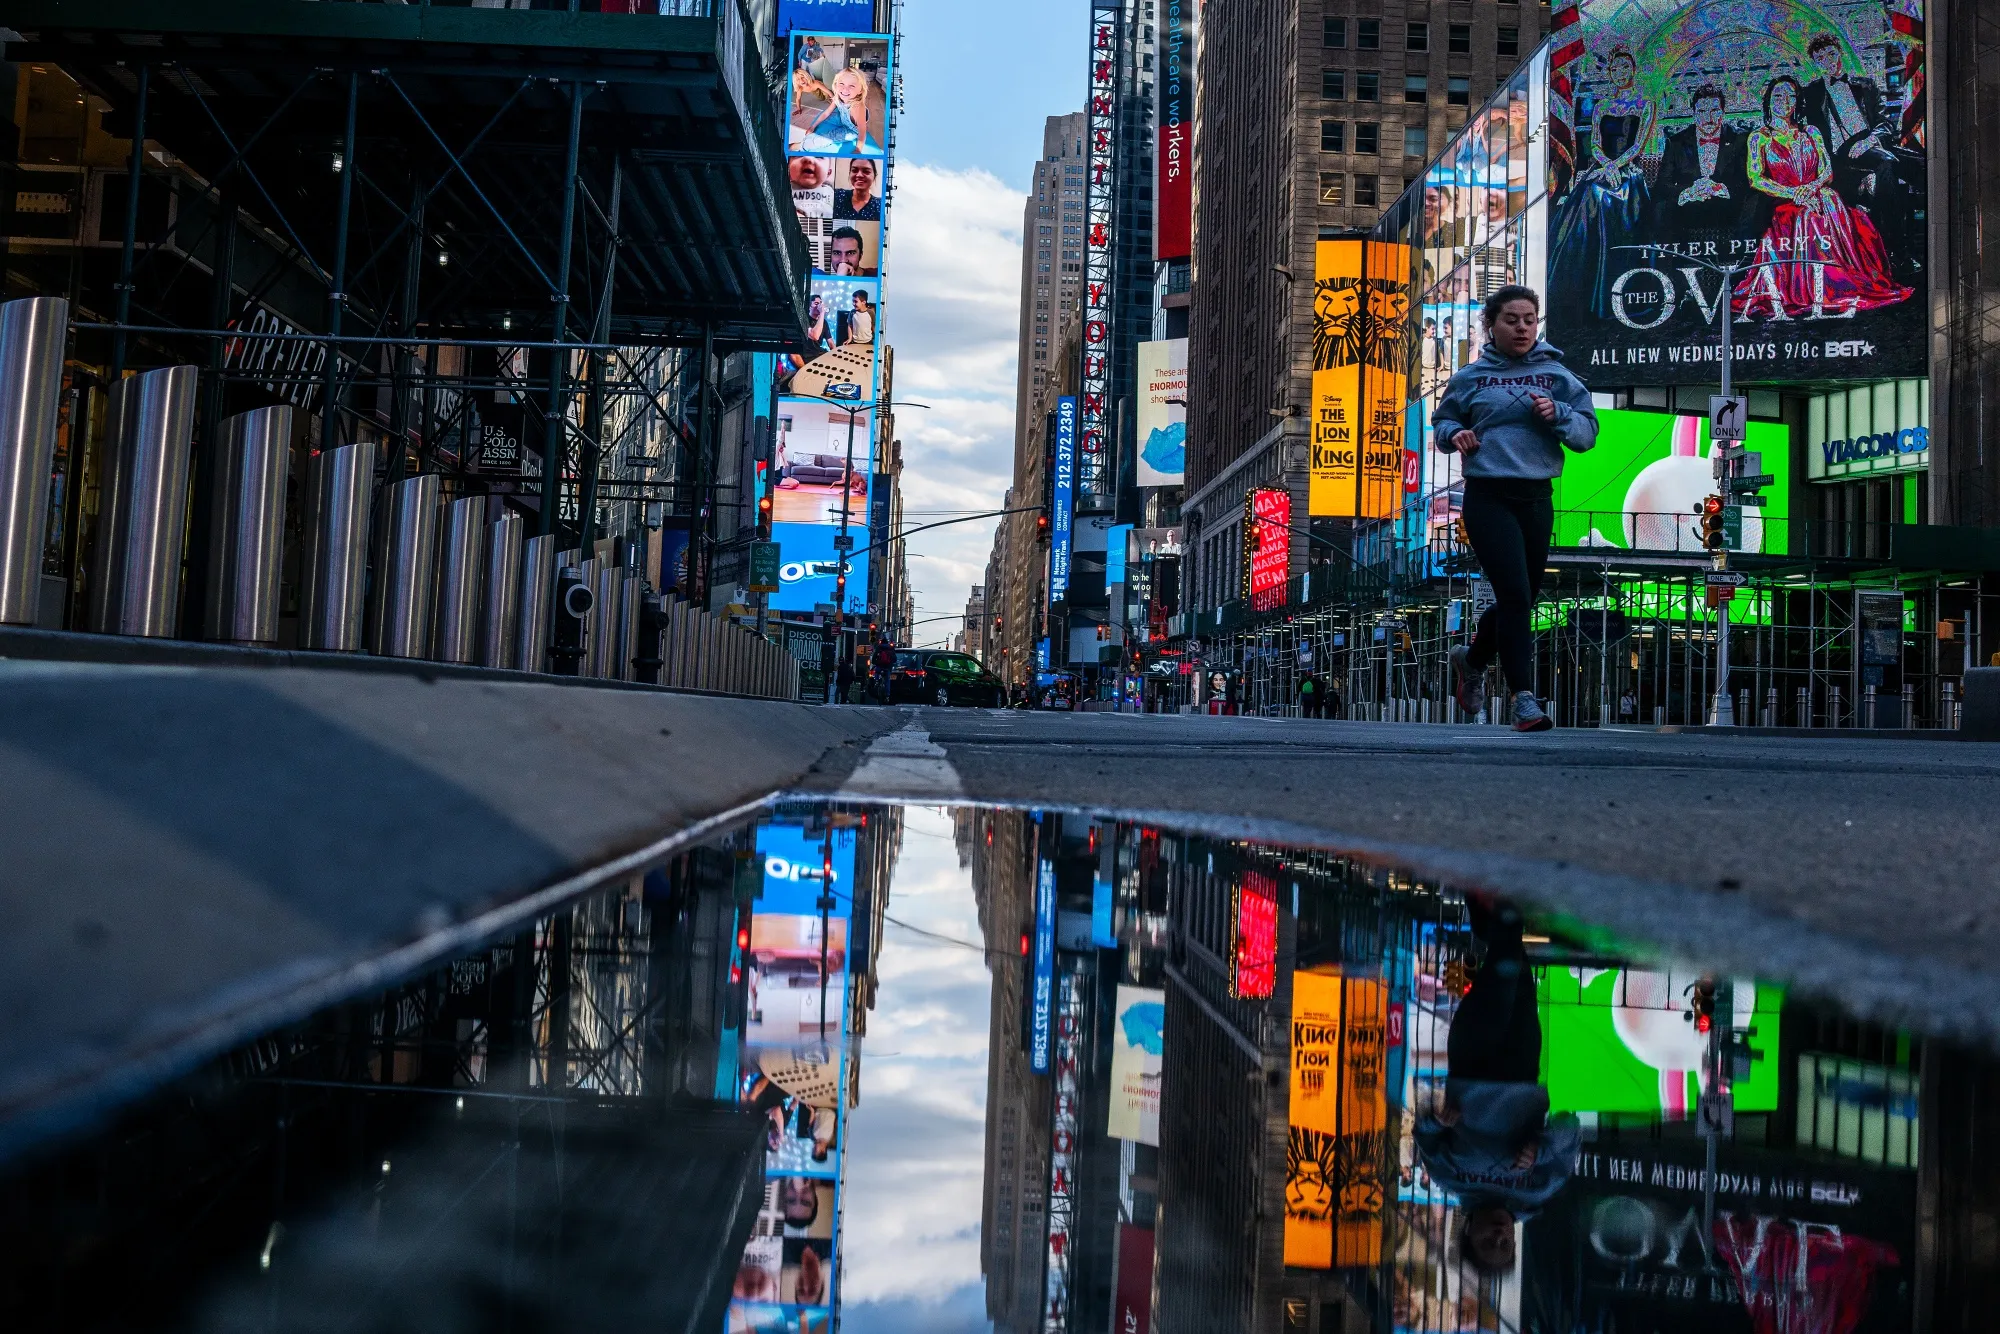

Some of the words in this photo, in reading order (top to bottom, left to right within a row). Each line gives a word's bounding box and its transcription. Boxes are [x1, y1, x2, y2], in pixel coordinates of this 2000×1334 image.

[1093, 26, 1111, 186] ERNST
[1168, 100, 1184, 183] workers.
[1639, 240, 1719, 259] TYLER
[1730, 235, 1832, 255] PERRY'S
[1611, 261, 1860, 330] OVAL
[1625, 291, 1659, 305] THE
[1591, 349, 1619, 365] ALL
[1627, 347, 1660, 364] NEW
[1082, 283, 1106, 454] YOUNG
[1155, 368, 1176, 378] These
[1476, 375, 1554, 390] HARVARD
[1320, 408, 1345, 421] THE
[484, 426, 506, 437] U.S.
[1316, 423, 1350, 443] LION
[1715, 427, 1740, 437] ONLY
[483, 437, 516, 448] POLO
[1057, 402, 1073, 489] 212.372.2349
[1822, 426, 1929, 464] VIACOMCB
[482, 448, 519, 459] ASSN.
[1312, 444, 1354, 469] KING
[1053, 548, 1061, 576] Newmark
[1252, 551, 1288, 572] MAKES
